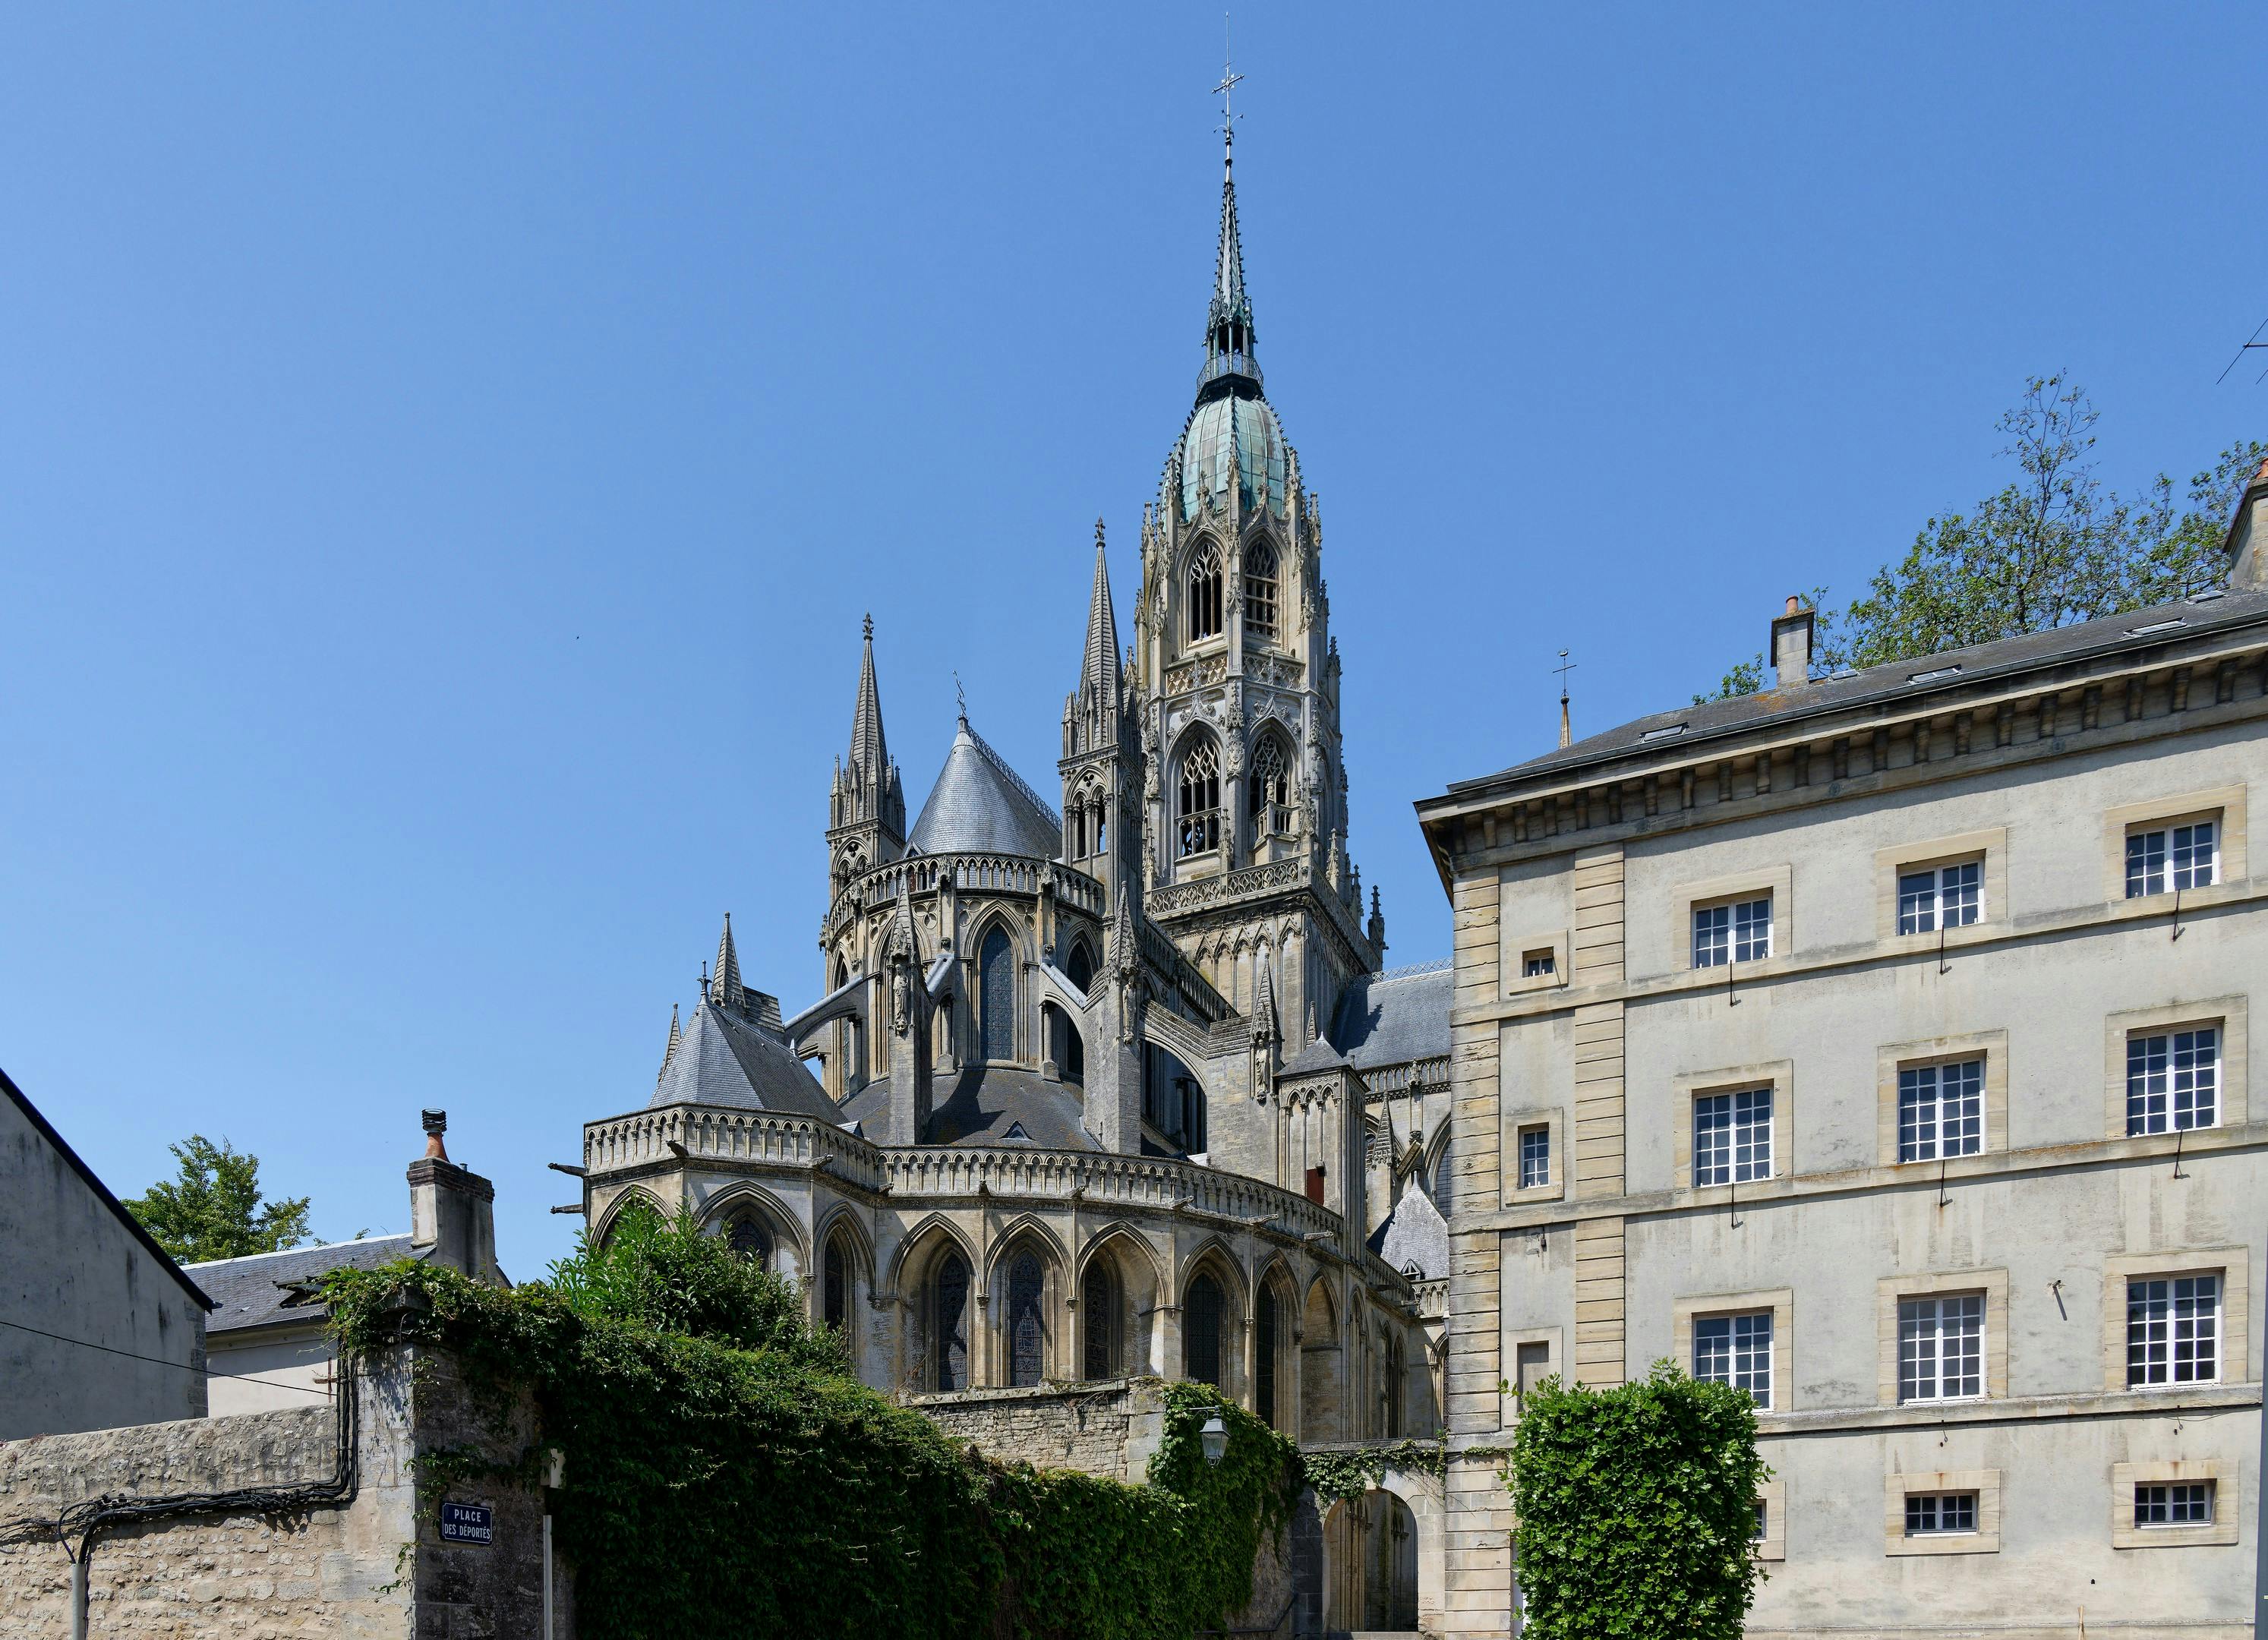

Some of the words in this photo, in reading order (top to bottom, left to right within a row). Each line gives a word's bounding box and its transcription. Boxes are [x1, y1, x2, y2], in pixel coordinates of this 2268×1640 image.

[454, 1509, 481, 1522] PLACE
[444, 1524, 456, 1535] DES
[459, 1524, 491, 1539] DÉPORTÉS
